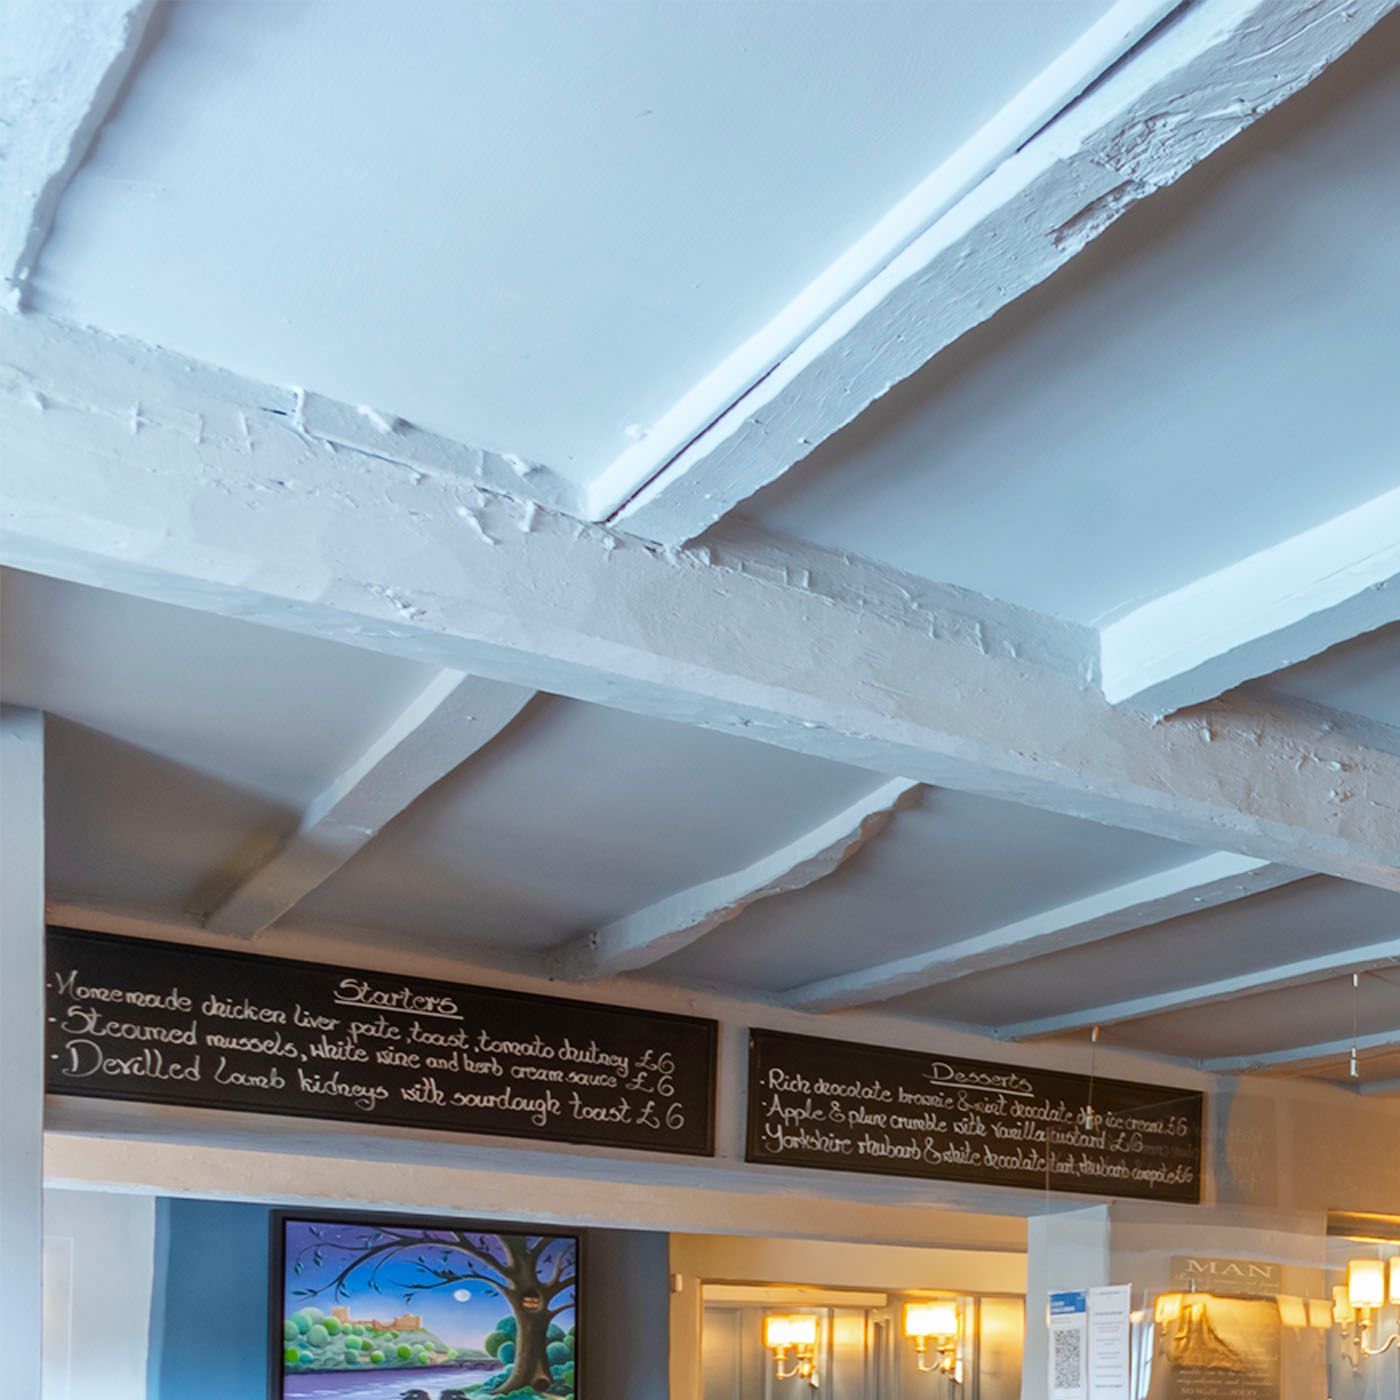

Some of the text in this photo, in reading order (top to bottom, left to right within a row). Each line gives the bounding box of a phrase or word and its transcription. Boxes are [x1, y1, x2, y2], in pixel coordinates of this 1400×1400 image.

[333, 978, 459, 1014] Starters
[201, 994, 288, 1024] chicken
[293, 1003, 341, 1031] liver
[478, 1029, 554, 1059] tomato
[558, 1037, 629, 1078] chutney
[61, 1038, 201, 1081] Devilled
[297, 1068, 389, 1111] kidneys
[400, 1076, 447, 1106] with
[450, 1086, 562, 1127] sourdough
[568, 1091, 632, 1125] toast
[309, 1034, 370, 1063] white
[376, 1045, 421, 1070] wine
[425, 1051, 460, 1072] and
[463, 1053, 503, 1077] herb
[510, 1063, 564, 1082] cream
[565, 1069, 618, 1088] sauce
[922, 1062, 1033, 1092] Desserts
[766, 1093, 826, 1127] Apple
[889, 1112, 948, 1133] crumble
[953, 1112, 987, 1137] with
[768, 1067, 812, 1094] Rich
[813, 1078, 893, 1103] chocolate
[898, 1086, 954, 1110] brownie
[1010, 1099, 1073, 1124] chocolate
[1076, 1105, 1103, 1131] chp
[765, 1122, 852, 1154] Yorkshire
[857, 1133, 922, 1160] rhubarb
[942, 1140, 981, 1166] white
[983, 1144, 1047, 1170] chocolate
[1186, 1259, 1273, 1278] MAN
